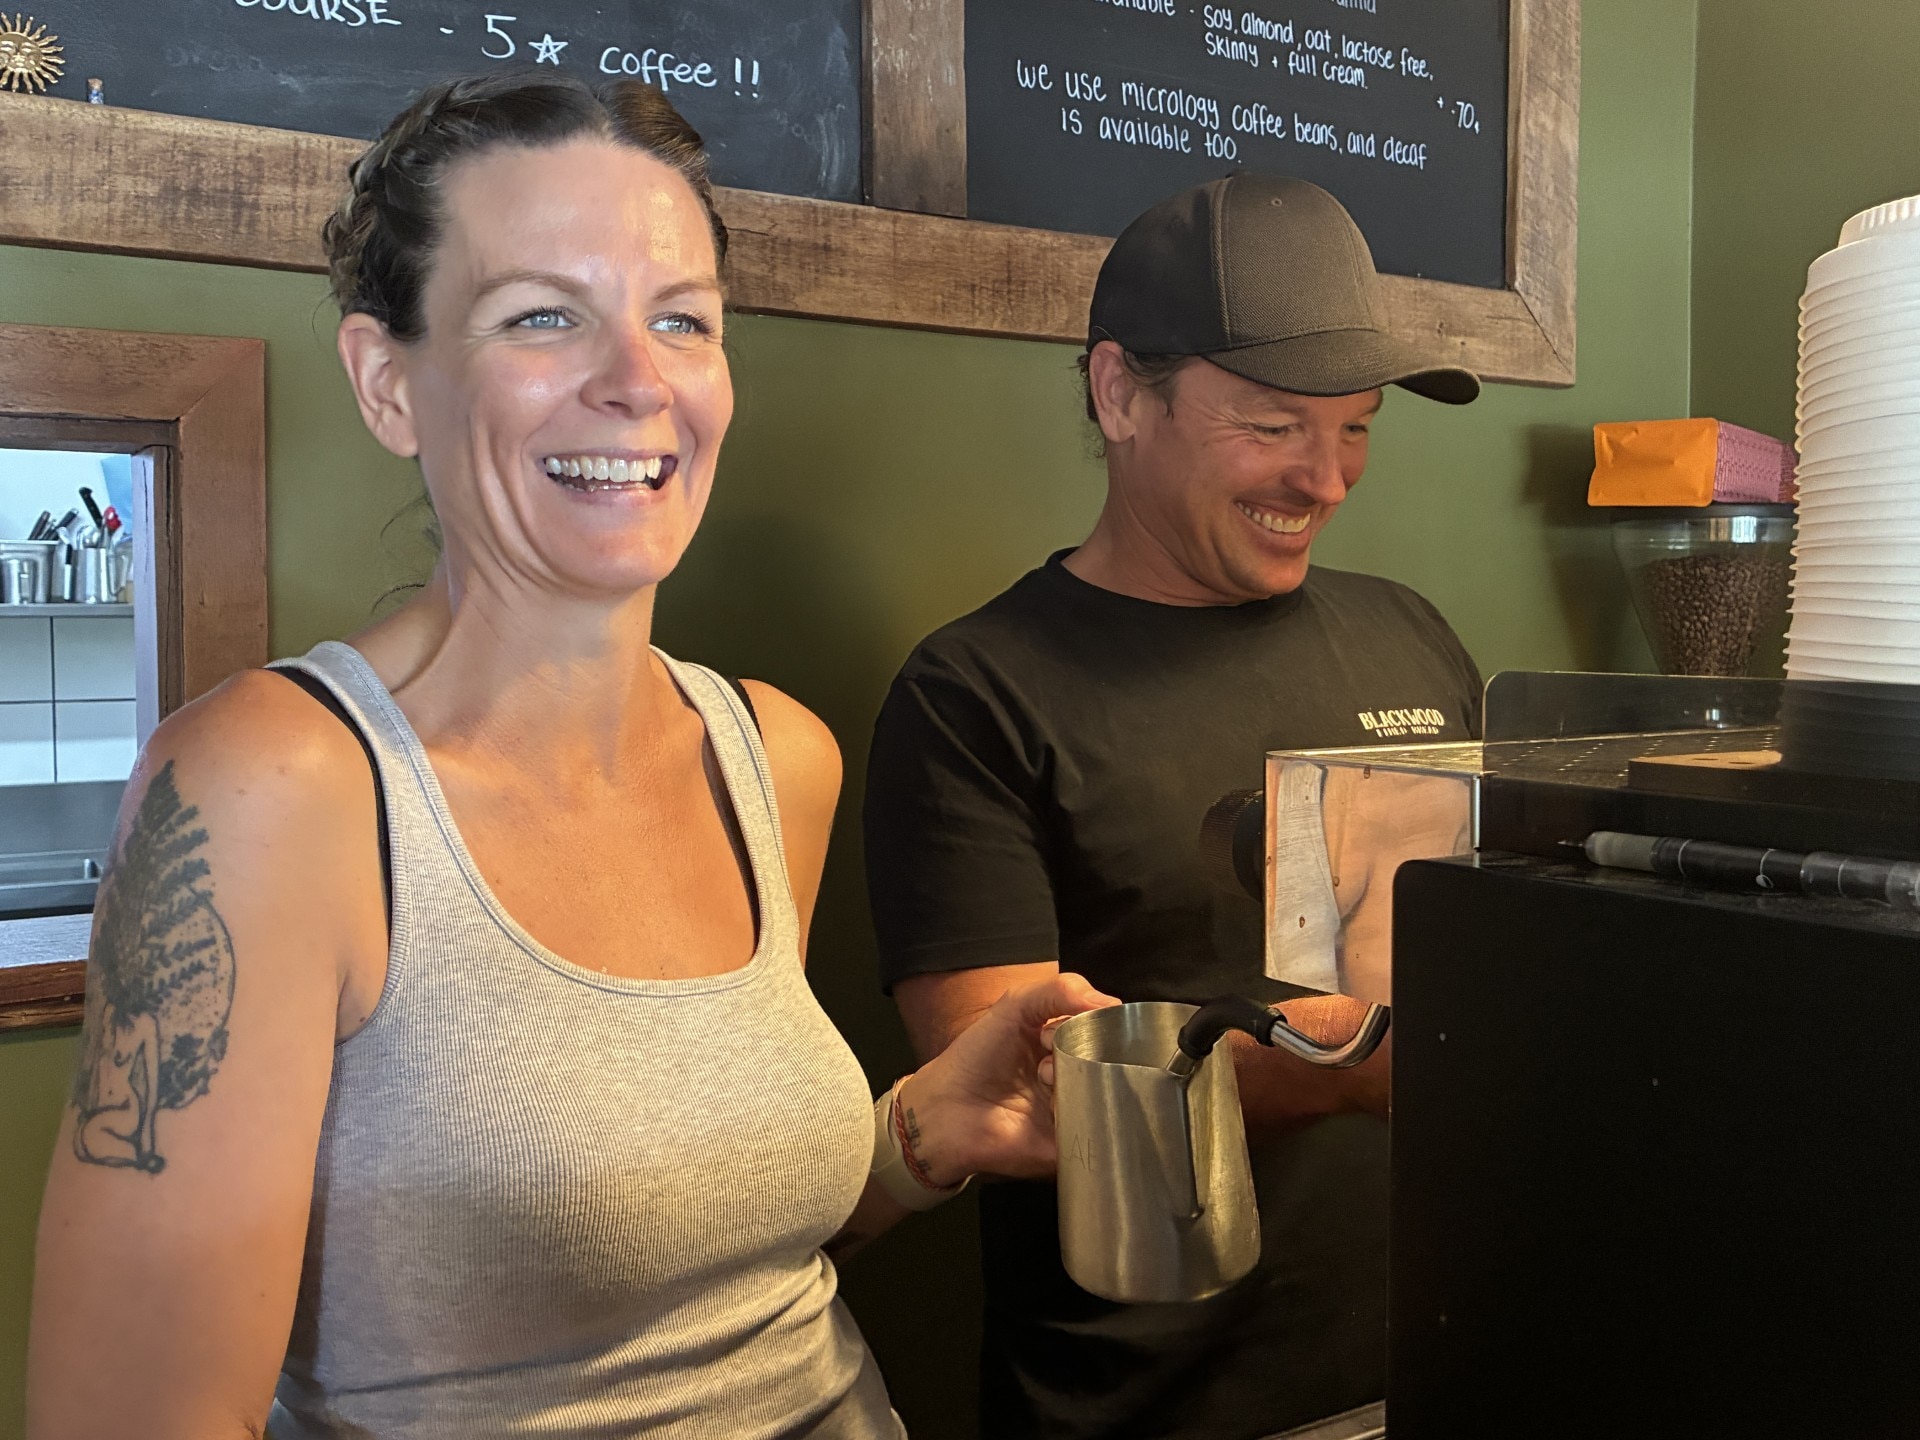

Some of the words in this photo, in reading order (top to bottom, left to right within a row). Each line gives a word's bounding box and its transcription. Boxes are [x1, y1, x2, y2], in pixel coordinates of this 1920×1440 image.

[481, 14, 517, 59] 5
[1341, 34, 1396, 70] lactose
[1288, 51, 1317, 77] full
[1065, 71, 1107, 101] use
[1121, 81, 1220, 131] micrology
[1347, 131, 1376, 158] and
[1383, 135, 1428, 171] decaf
[1099, 116, 1192, 154] available
[1357, 708, 1445, 730] BLACKWOOD
